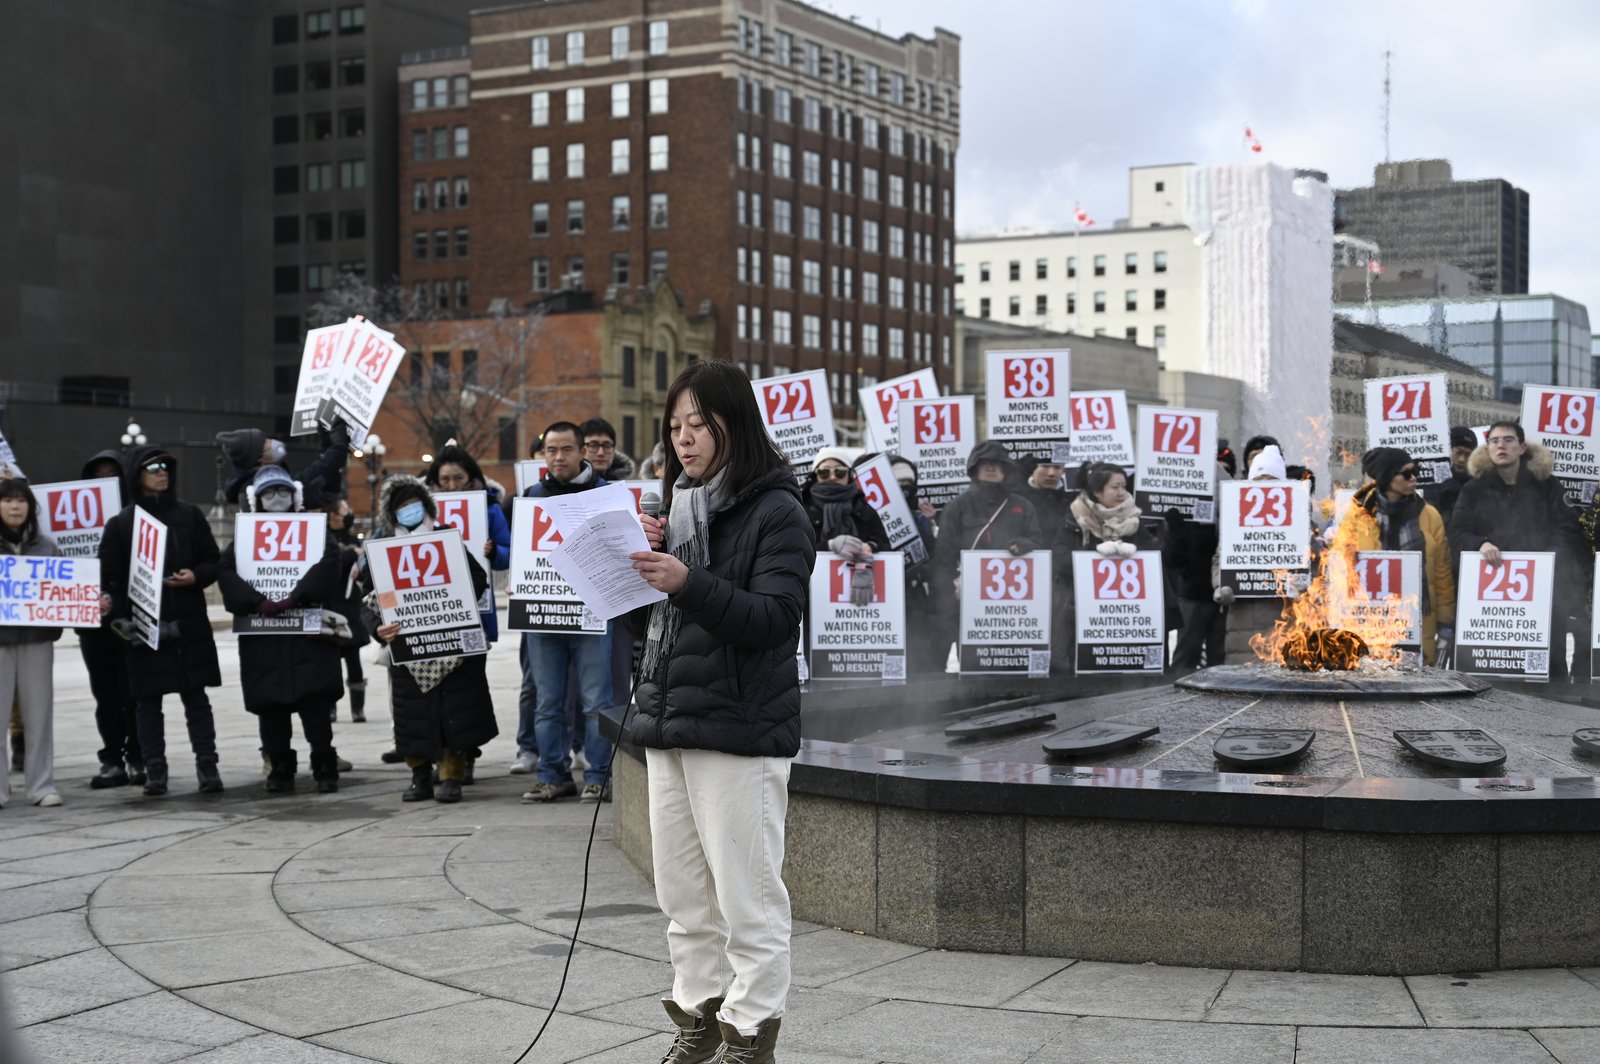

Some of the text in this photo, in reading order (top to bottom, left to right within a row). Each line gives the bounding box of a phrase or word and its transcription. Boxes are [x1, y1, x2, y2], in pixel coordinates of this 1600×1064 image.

[358, 337, 390, 380] 23
[1008, 358, 1049, 397] 38
[769, 381, 811, 424] 22
[882, 380, 916, 421] 27
[1387, 384, 1425, 419] 27
[1009, 402, 1048, 411] MONTHS
[998, 413, 1059, 423] WAITING FOR
[1075, 398, 1109, 430] 19
[1545, 394, 1587, 435] 18
[920, 405, 956, 443] 31
[993, 424, 1064, 435] IRCC RESPONSE
[1389, 424, 1428, 434] MONTHS
[775, 424, 813, 438] MONTHS
[1159, 415, 1196, 454] 72
[777, 434, 825, 451] AITING FOR
[1379, 436, 1418, 445] WAITING
[1542, 438, 1585, 451] MONTHS
[920, 447, 956, 457] MONTHS
[1071, 443, 1123, 453] WAITING FOR
[1404, 444, 1444, 455] SPONSE
[1157, 457, 1195, 467] MONTHS
[1550, 450, 1595, 463] TING FOR
[949, 458, 966, 467] FOR
[927, 469, 966, 480] RESPONS
[1147, 468, 1204, 480] WAITING FOR
[1553, 463, 1600, 476] ESPONSE
[857, 470, 885, 510] 5
[1141, 478, 1208, 491] IRCC RESPONSE
[54, 488, 99, 530] 40
[1244, 487, 1287, 526] 23
[436, 500, 464, 541] 5
[886, 517, 904, 533] FOR
[537, 508, 562, 551] 2
[889, 525, 912, 543] ONSE
[57, 533, 100, 545] MONTHS
[258, 521, 302, 560] 34
[1244, 532, 1286, 541] MONTHS
[139, 521, 155, 570] 11
[1232, 543, 1274, 552] WAITING
[397, 543, 445, 587] 42
[1226, 555, 1303, 565] IRCC RESPONSE
[25, 559, 74, 580] THE
[257, 567, 299, 576] MONTHS
[524, 571, 566, 582] WAITIN
[985, 558, 1028, 600] 33
[1098, 559, 1140, 599] 28
[1236, 572, 1248, 581] NO
[1483, 561, 1529, 600] 25
[516, 584, 577, 596] IRCC RESP
[1239, 582, 1252, 591] NO
[402, 588, 449, 603] MONTHS
[394, 599, 464, 617] WAITING FOR
[526, 603, 583, 614] NO TIMELINE
[985, 605, 1027, 615] MONTHS
[1099, 604, 1140, 614] MONTHS
[1482, 607, 1526, 616] MONTHS
[391, 610, 473, 629] RCC RESPONSE
[835, 609, 880, 619] MONTHS
[251, 618, 300, 627] NO RESULTS
[529, 615, 583, 626] NO RESULTS
[974, 618, 1038, 627] WAITING FOR
[1089, 616, 1152, 626] WAITING FOR
[1470, 619, 1537, 629] WAITING FOR
[824, 622, 892, 632] WAITING FOR
[405, 630, 461, 646] NO TIMELINE
[818, 634, 898, 644] IRCC RESPONSE
[967, 630, 1044, 640] IRCC RESPONSE
[1084, 629, 1157, 638] IRCC RESPONSE
[1463, 631, 1543, 642] IRCC RESPONSE
[411, 641, 463, 655] NO RESULTS
[977, 648, 988, 656] NO
[1092, 646, 1104, 655] NO
[1472, 648, 1526, 658] NO TIMELINE
[828, 653, 841, 662] NO
[980, 658, 1029, 667] NO RESULTS
[1096, 656, 1144, 665] NO RESULTS
[832, 664, 883, 672] NO RESULTS
[1475, 659, 1526, 669] NO RESULTS
